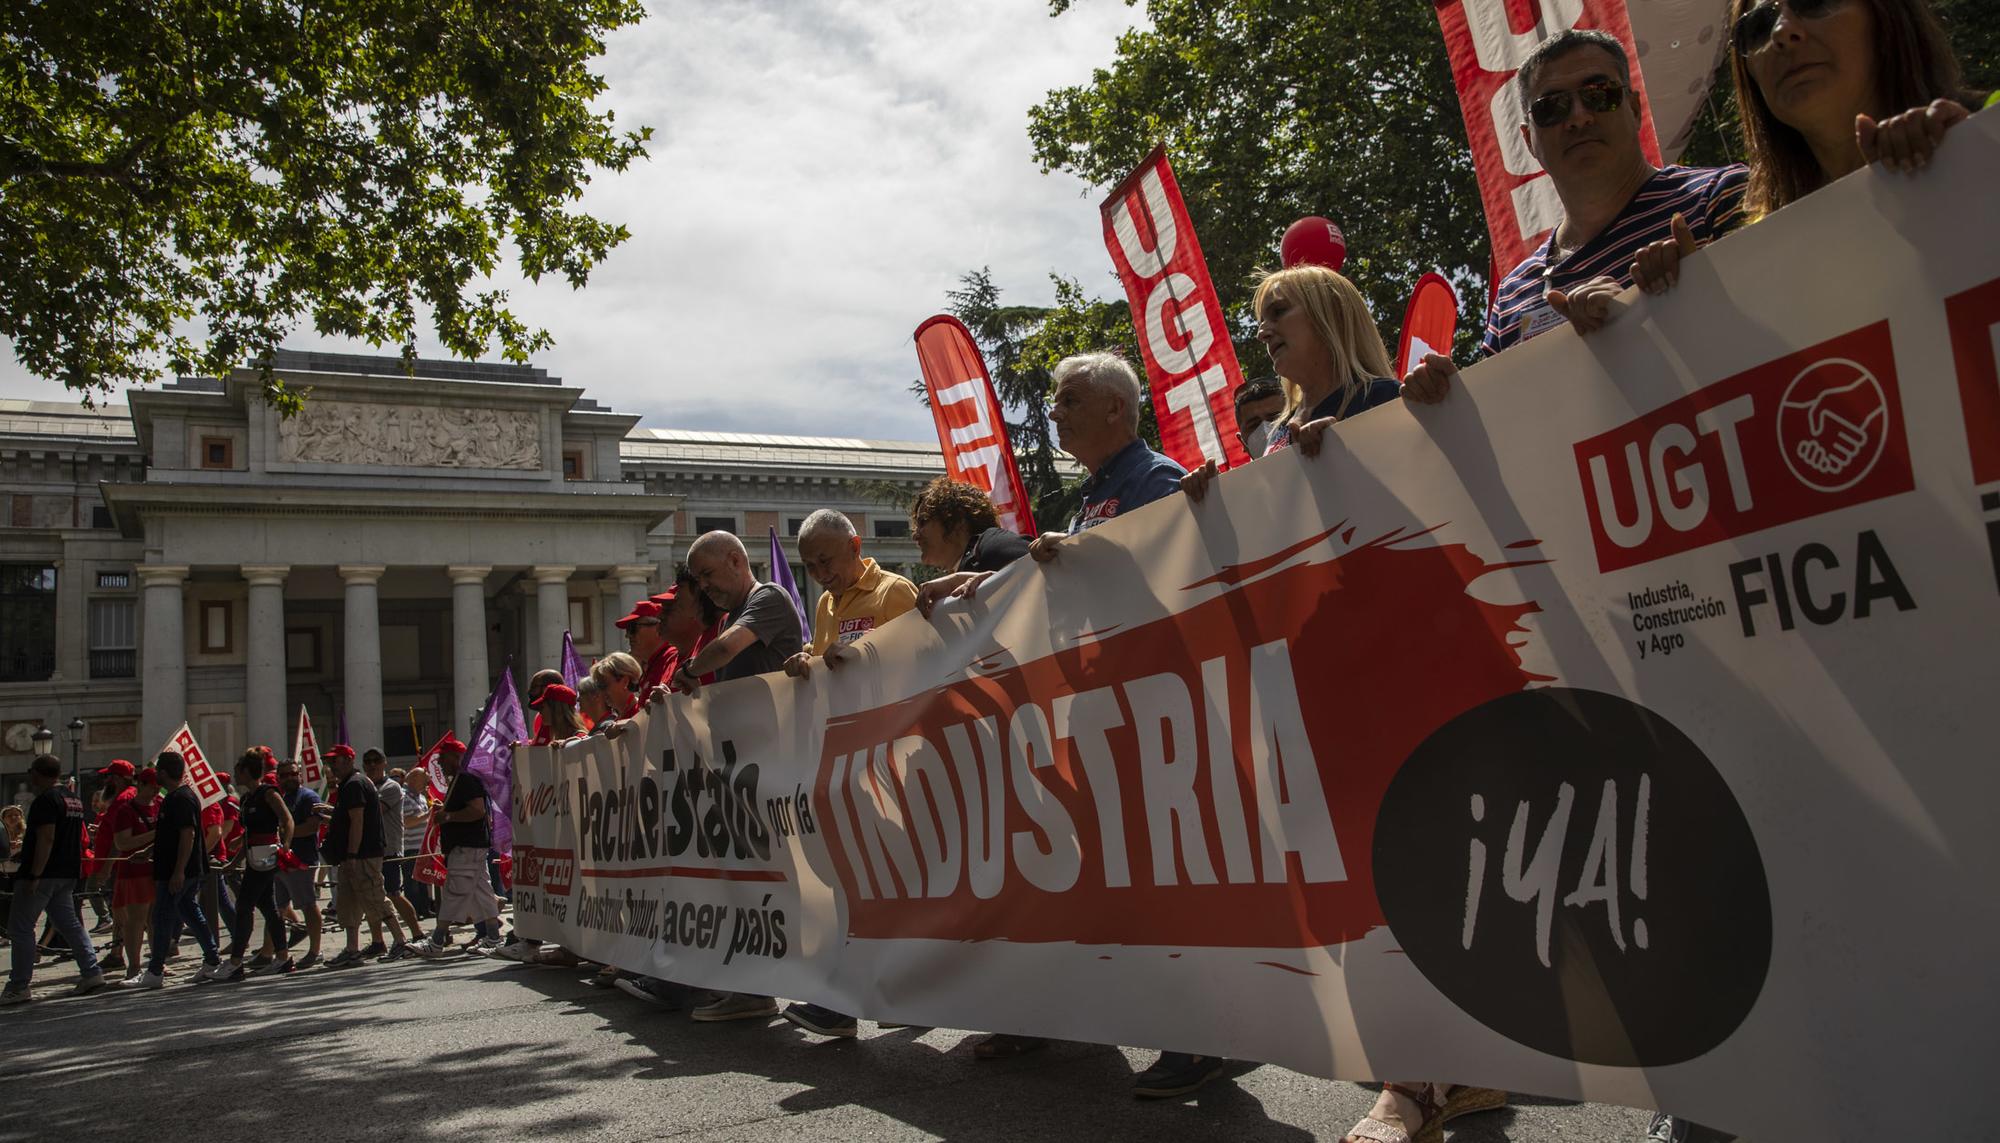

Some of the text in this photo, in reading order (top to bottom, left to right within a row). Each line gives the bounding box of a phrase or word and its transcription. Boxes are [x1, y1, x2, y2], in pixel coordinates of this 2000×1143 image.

[1110, 165, 1228, 467] UGT
[1588, 393, 1755, 549] UGT
[1628, 580, 1694, 610] Industria,
[1633, 596, 1726, 632] Construcción
[1728, 529, 1918, 638] FICA
[840, 619, 861, 632] UGT
[1637, 633, 1685, 660] y Agro
[829, 637, 1348, 900] INDUSTRIA
[767, 783, 816, 848] por la
[517, 891, 537, 913] FICA
[1462, 773, 1650, 968] ¡YA!
[661, 889, 728, 950] acer
[723, 894, 788, 965] país
